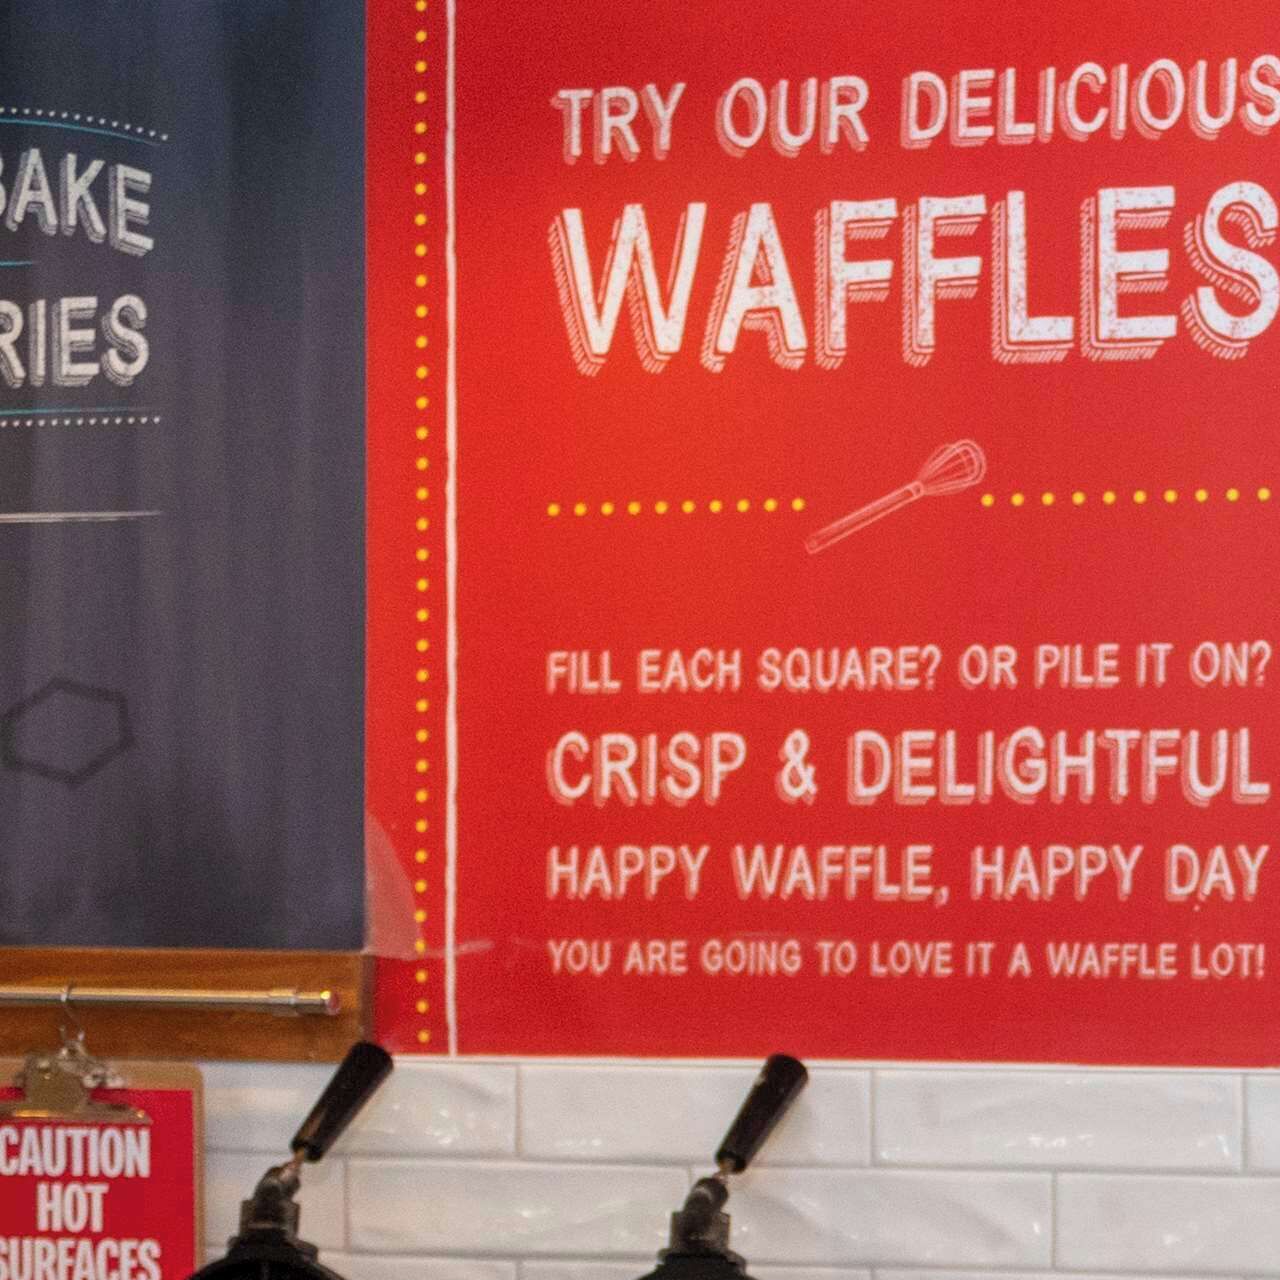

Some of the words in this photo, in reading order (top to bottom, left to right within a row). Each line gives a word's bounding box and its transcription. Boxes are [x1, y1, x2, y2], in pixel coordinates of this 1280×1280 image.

[554, 82, 686, 164] TRY
[716, 76, 869, 156] OUR
[0, 148, 154, 257] AKE
[546, 650, 621, 693] FILL
[637, 648, 742, 692] EACH
[757, 645, 942, 692] SQUARE?
[959, 644, 1018, 689] OR
[1034, 643, 1120, 688] PILE
[1136, 643, 1173, 688] IT
[1190, 640, 1272, 687] ON?
[546, 731, 747, 808] CRISP
[775, 729, 818, 805] &
[847, 726, 1271, 807] DELIGHTFUL
[546, 844, 709, 900] HAPPY
[731, 844, 949, 907] WAFFLE,
[971, 844, 1143, 900] HAPPY
[1165, 844, 1269, 901] DAY
[548, 939, 612, 976] YOU
[624, 939, 687, 976] ARE
[701, 938, 801, 976] GOING
[816, 940, 857, 976] TO
[870, 940, 953, 977] LOVE
[966, 942, 995, 976] IT
[1008, 942, 1031, 976] A
[1046, 942, 1178, 979] WAFFLE
[1190, 942, 1266, 979] LOT!
[0, 1126, 150, 1179] CAUTION
[36, 1182, 109, 1233] HOT
